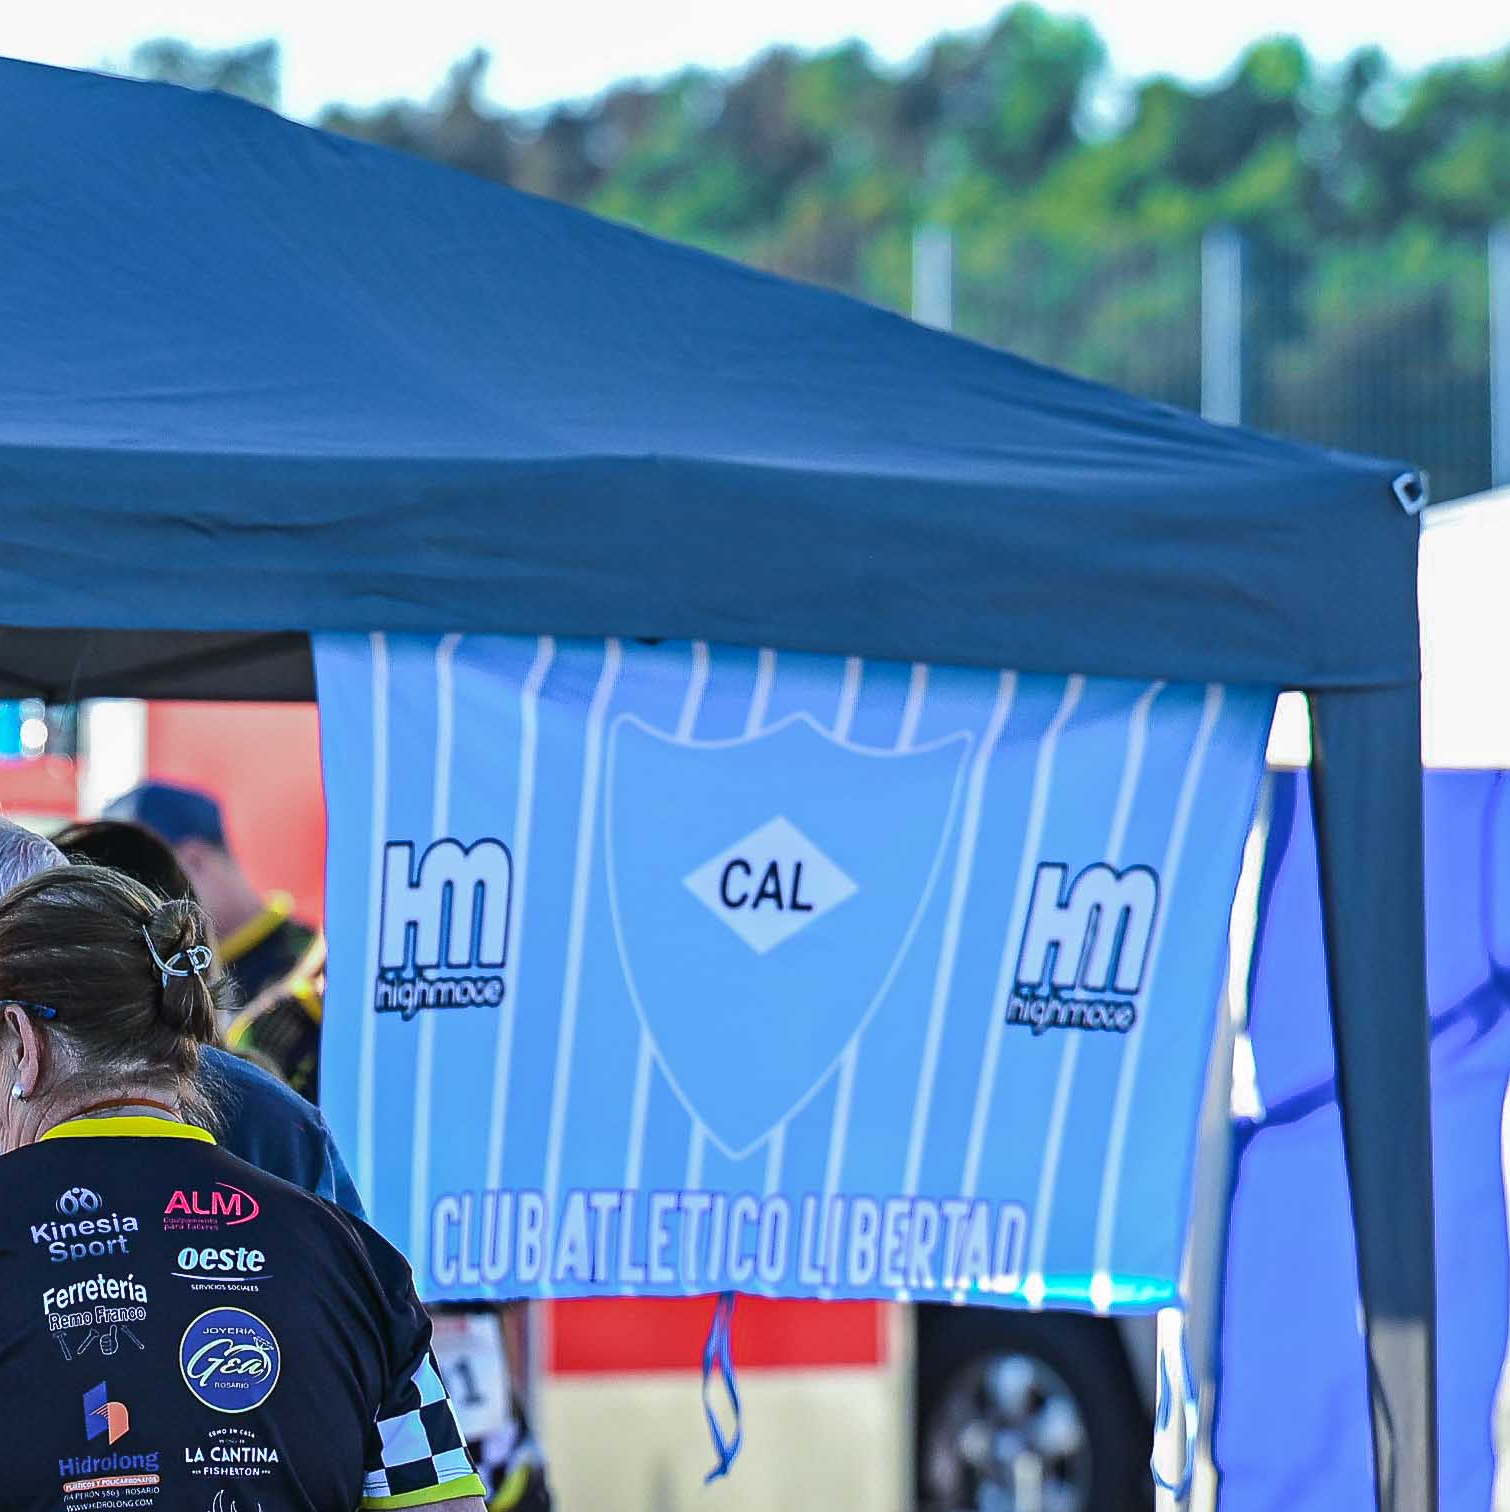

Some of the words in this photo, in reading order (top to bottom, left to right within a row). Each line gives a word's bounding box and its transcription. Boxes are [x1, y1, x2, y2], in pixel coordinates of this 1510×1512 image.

[719, 857, 814, 915] CAL
[378, 837, 514, 969] HM
[1014, 862, 1161, 996] HM
[374, 966, 506, 1022] highmove
[1004, 986, 1137, 1036] highmove
[163, 1189, 242, 1216] ALM
[30, 1212, 140, 1245] Kinesia
[48, 1234, 130, 1263] Sport
[432, 1192, 545, 1286] CLUB
[797, 1196, 1027, 1294] LIBERTAD
[177, 1246, 266, 1272] oeste
[42, 1273, 148, 1316] Ferretería
[191, 1283, 226, 1292] SERVICIOS
[227, 1284, 260, 1293] SOCIALES
[48, 1311, 92, 1332] Remo
[94, 1304, 147, 1325] Franco
[202, 1326, 257, 1336] JOYERIA
[214, 1381, 250, 1390] ROSARIO
[58, 1450, 162, 1477] Hidrolong
[185, 1446, 205, 1464] LA
[209, 1446, 280, 1464] CANTINA
[202, 1466, 261, 1477] FISHERTON
[125, 1486, 160, 1496] ROSARIO
